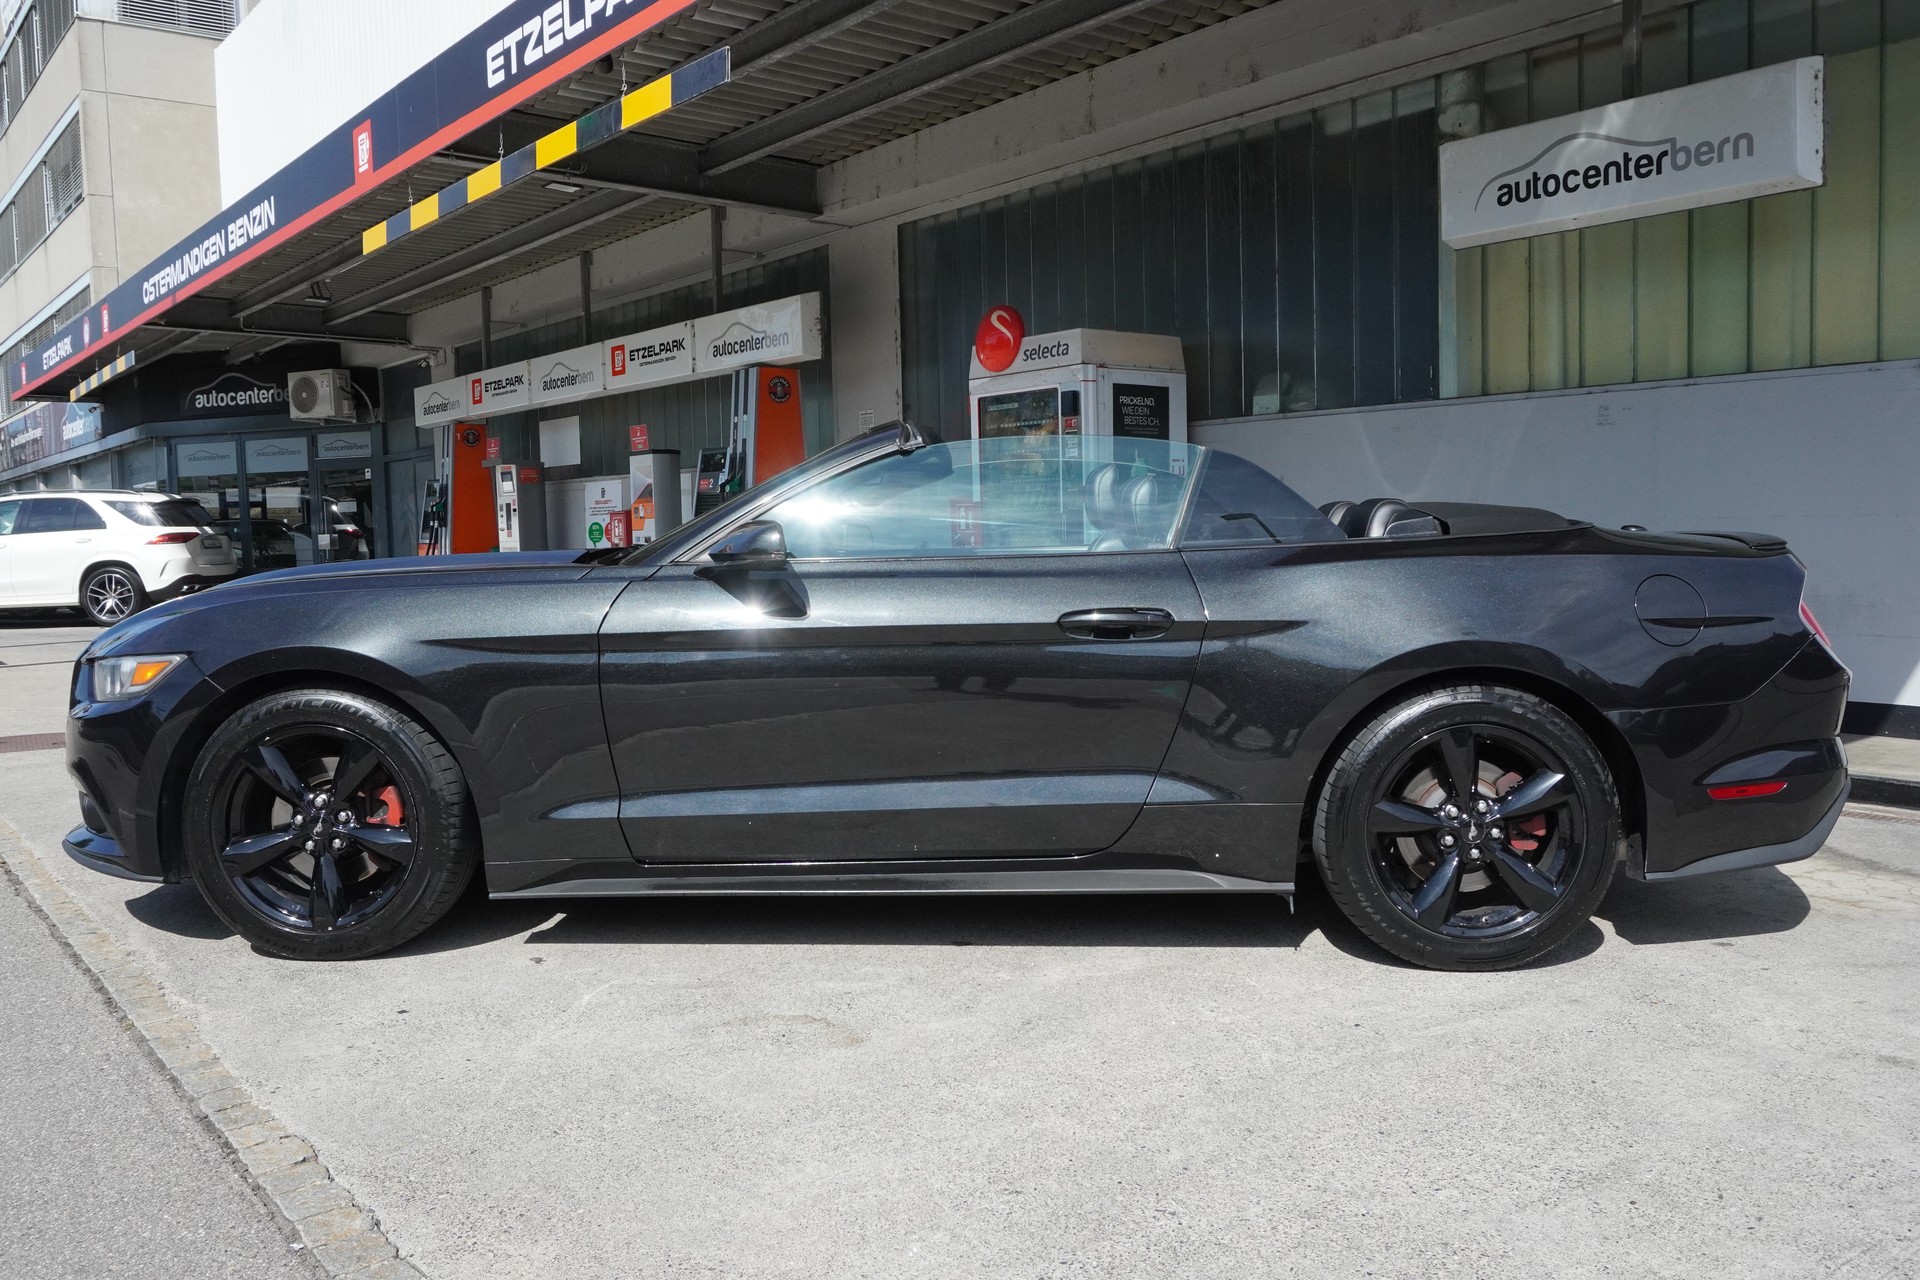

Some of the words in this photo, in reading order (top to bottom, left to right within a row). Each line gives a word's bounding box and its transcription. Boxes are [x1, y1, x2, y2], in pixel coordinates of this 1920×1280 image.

[1496, 132, 1754, 207] autocenterbern
[142, 229, 226, 304] OSTERMUNDIGEN
[227, 195, 275, 252] BENZIN
[42, 335, 73, 371] ETZELPARK
[629, 337, 686, 362] ETZELPARK
[712, 331, 790, 358] autocenterbern
[1022, 340, 1070, 361] selecta
[484, 374, 525, 393] ETZELPARK
[542, 370, 595, 391] autocenterbern
[195, 383, 290, 408] autocenterbe
[423, 399, 461, 416] autocenterbern
[1124, 415, 1147, 426] BESTES
[708, 478, 715, 489] 2
